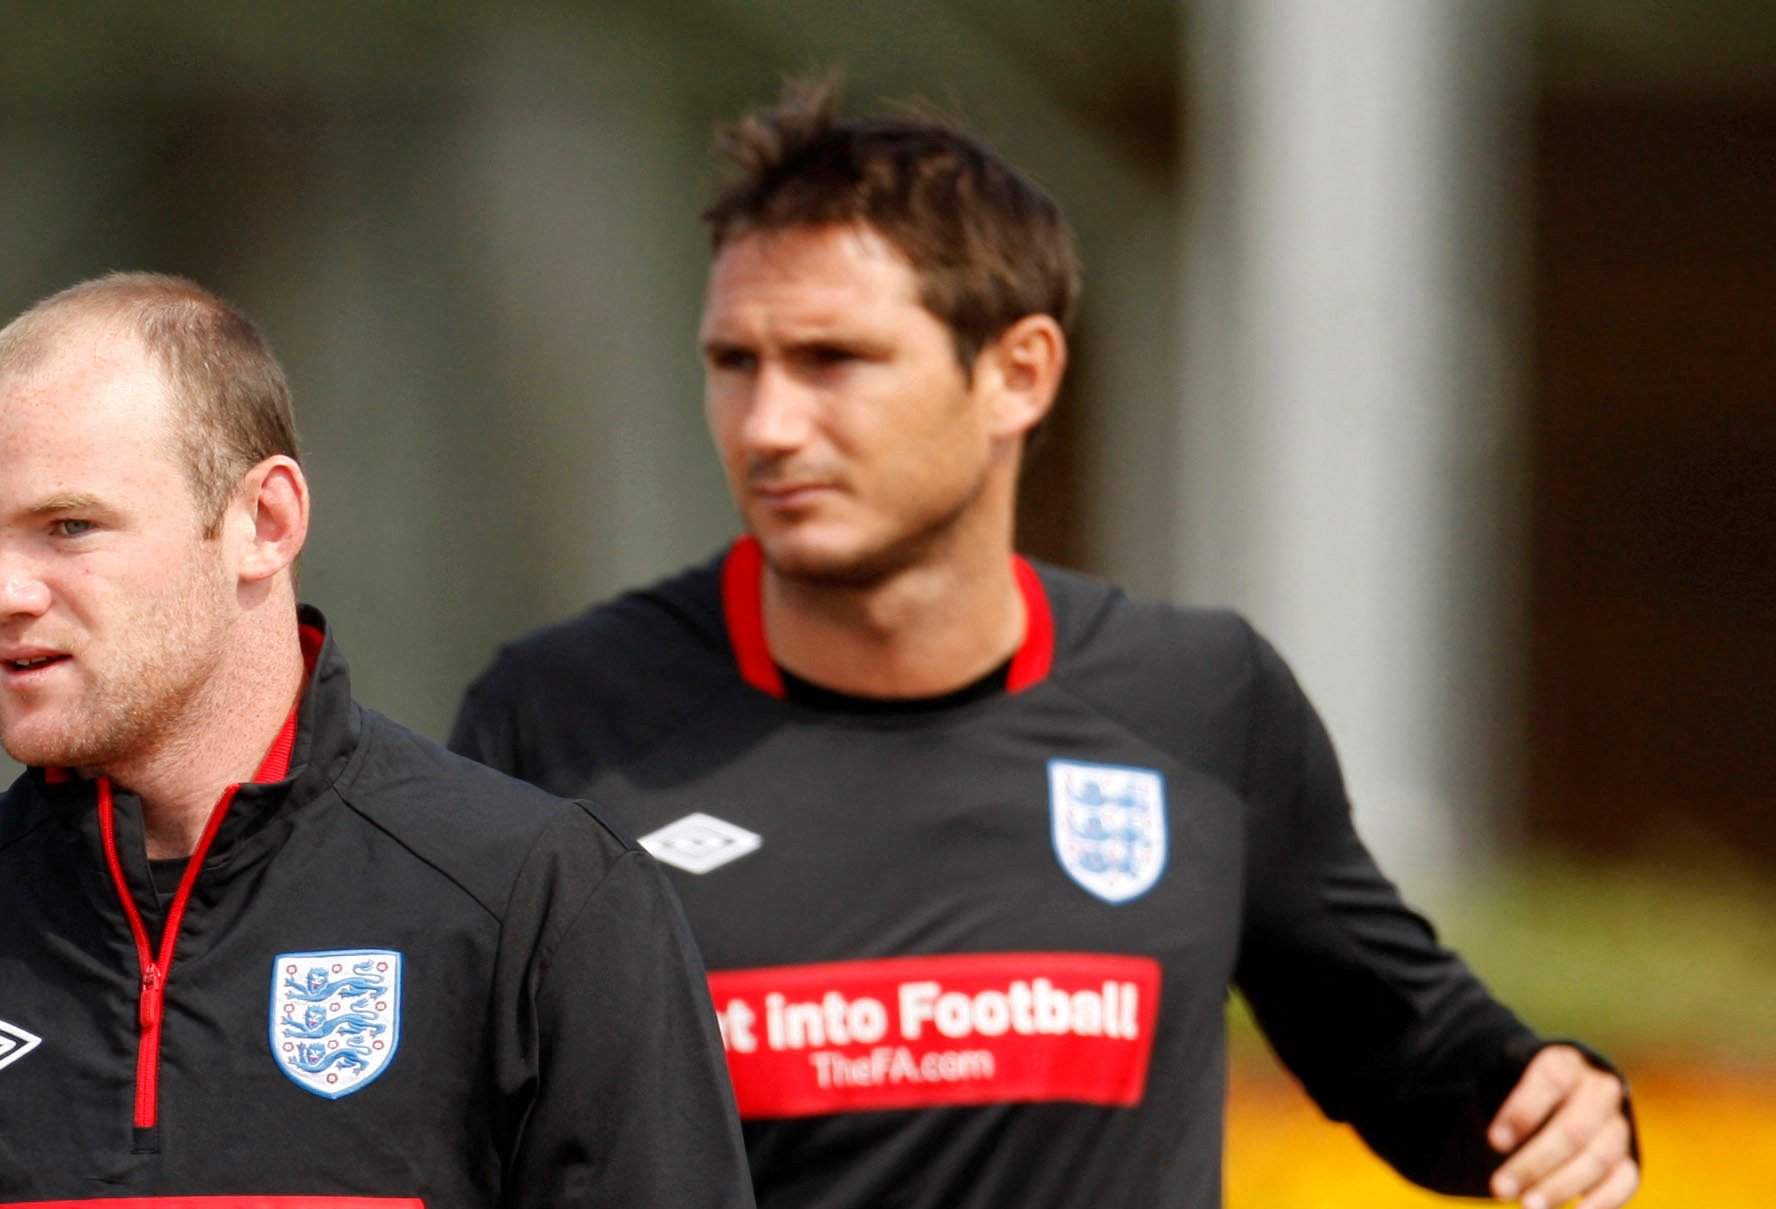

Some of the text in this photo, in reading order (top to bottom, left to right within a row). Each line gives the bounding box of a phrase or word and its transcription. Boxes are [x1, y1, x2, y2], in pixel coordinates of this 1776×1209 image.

[765, 990, 888, 1051] into
[898, 976, 1139, 1041] Football
[811, 1045, 994, 1088] TheFA.com
